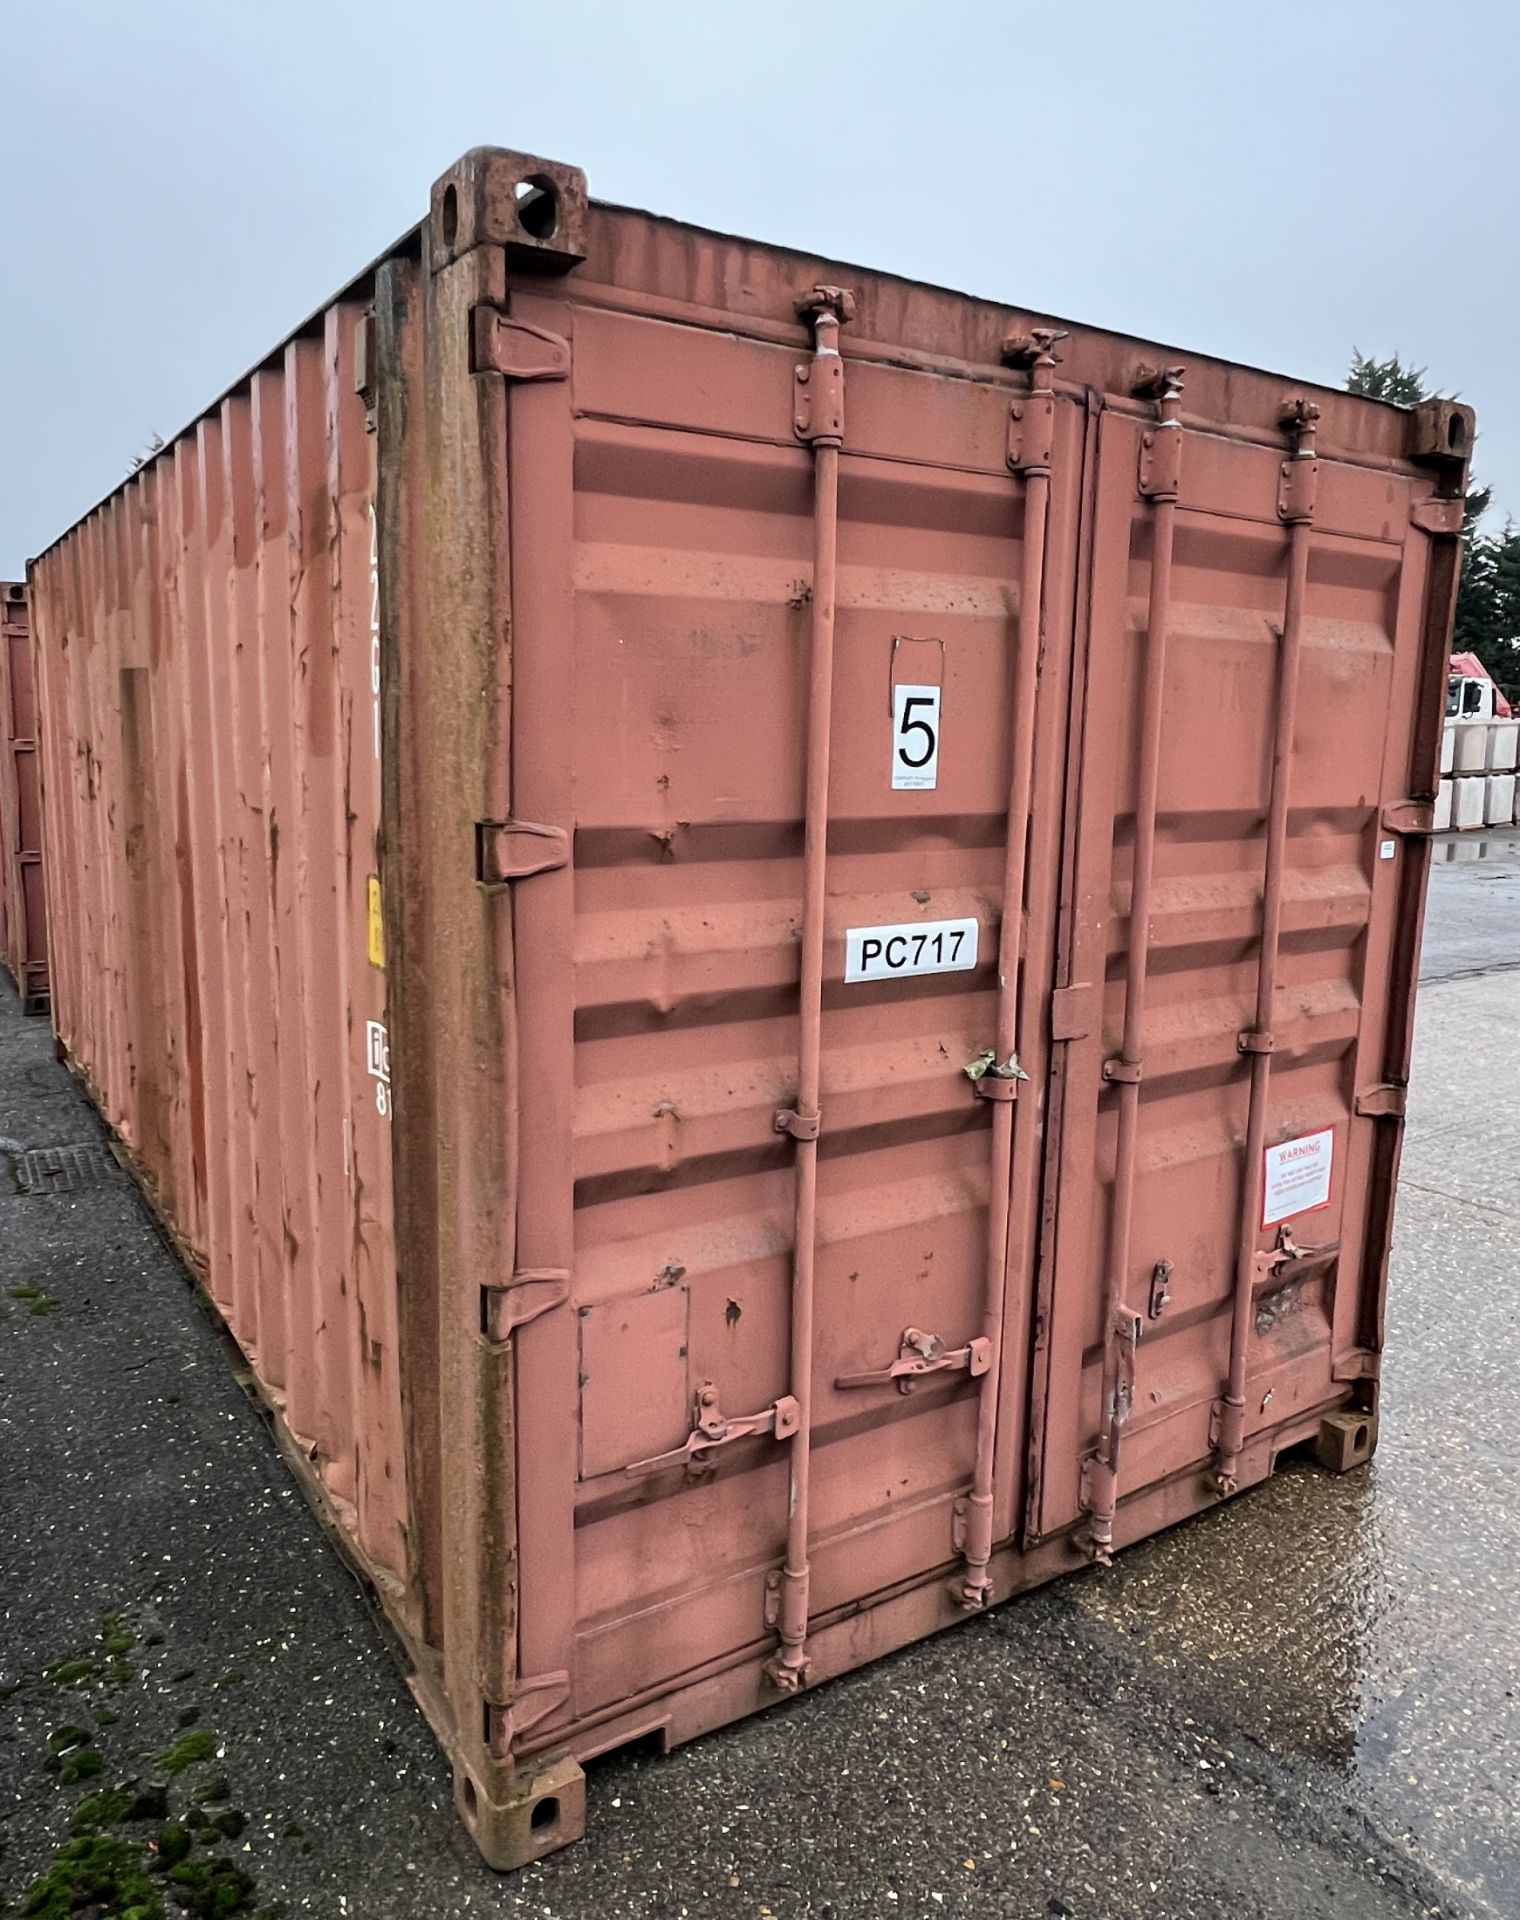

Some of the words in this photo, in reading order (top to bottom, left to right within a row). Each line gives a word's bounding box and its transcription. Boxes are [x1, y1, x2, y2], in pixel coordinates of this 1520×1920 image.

[898, 697, 936, 769] 5
[861, 930, 966, 971] PC717
[1279, 1141, 1321, 1164] WARNING
